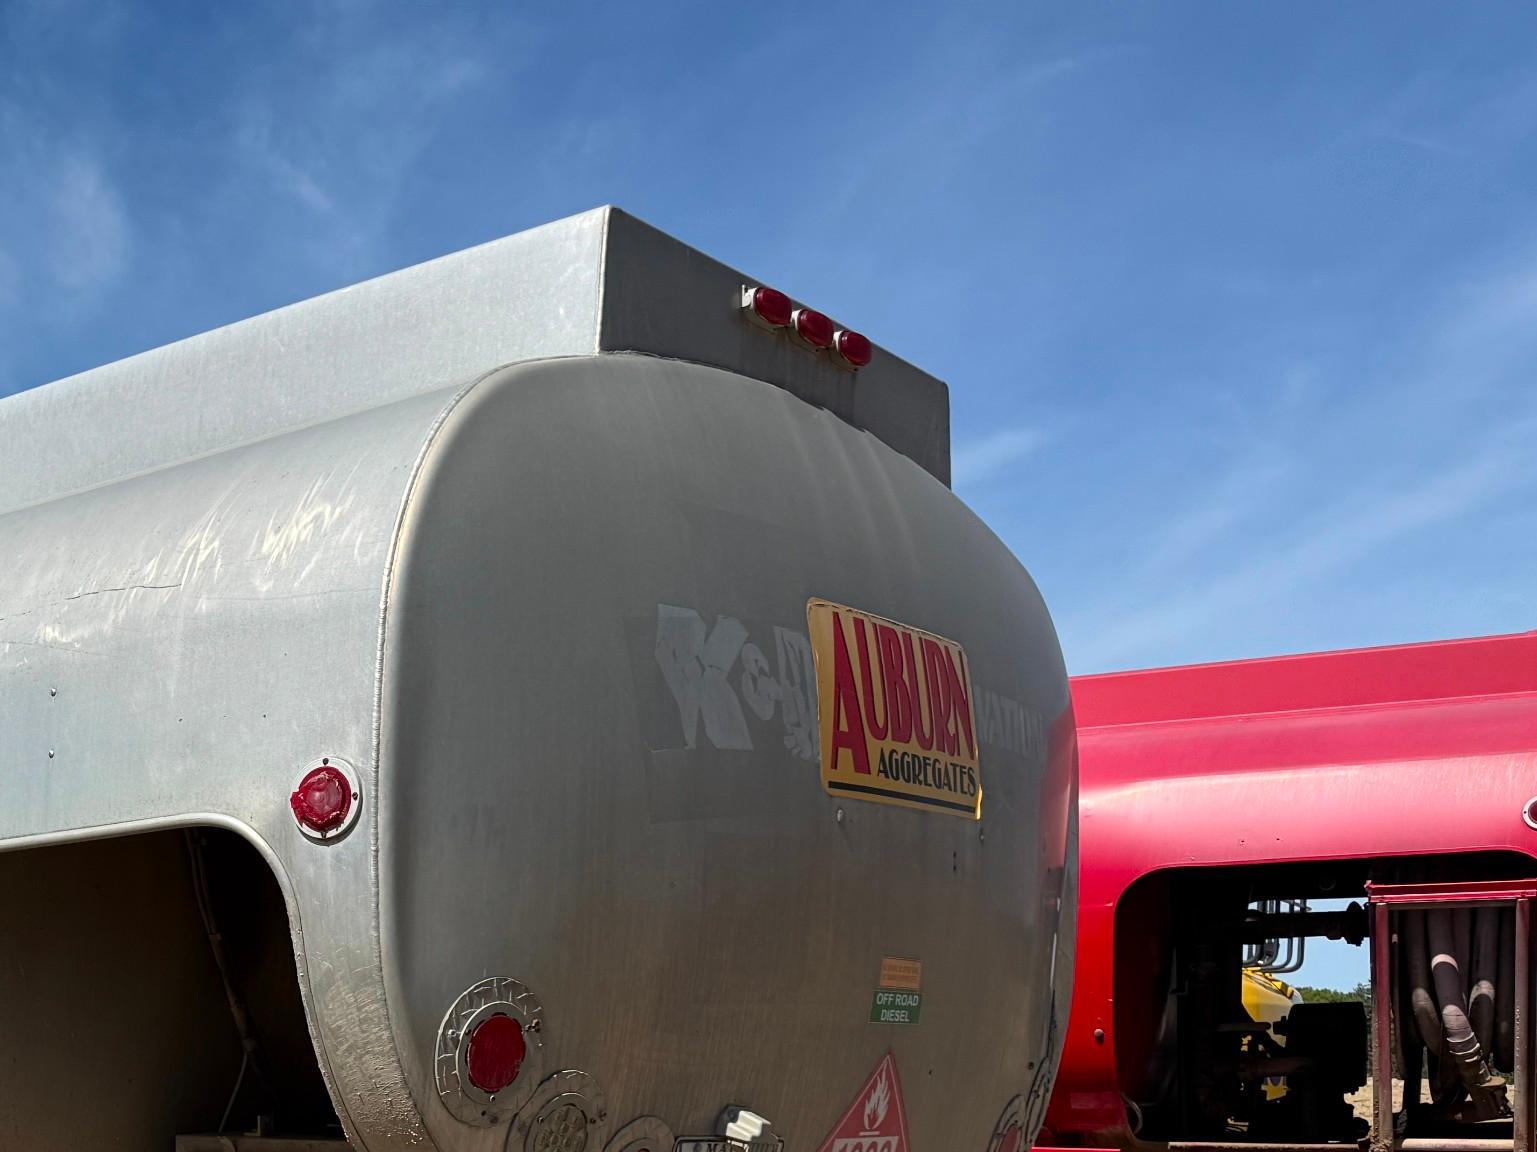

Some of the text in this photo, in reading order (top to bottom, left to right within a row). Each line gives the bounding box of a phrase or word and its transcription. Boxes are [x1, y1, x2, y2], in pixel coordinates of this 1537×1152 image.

[830, 611, 976, 775] AUBURN
[877, 747, 977, 798] AGGREGATES
[876, 992, 919, 1007] OFF ROAD
[880, 1009, 910, 1022] DIESEL
